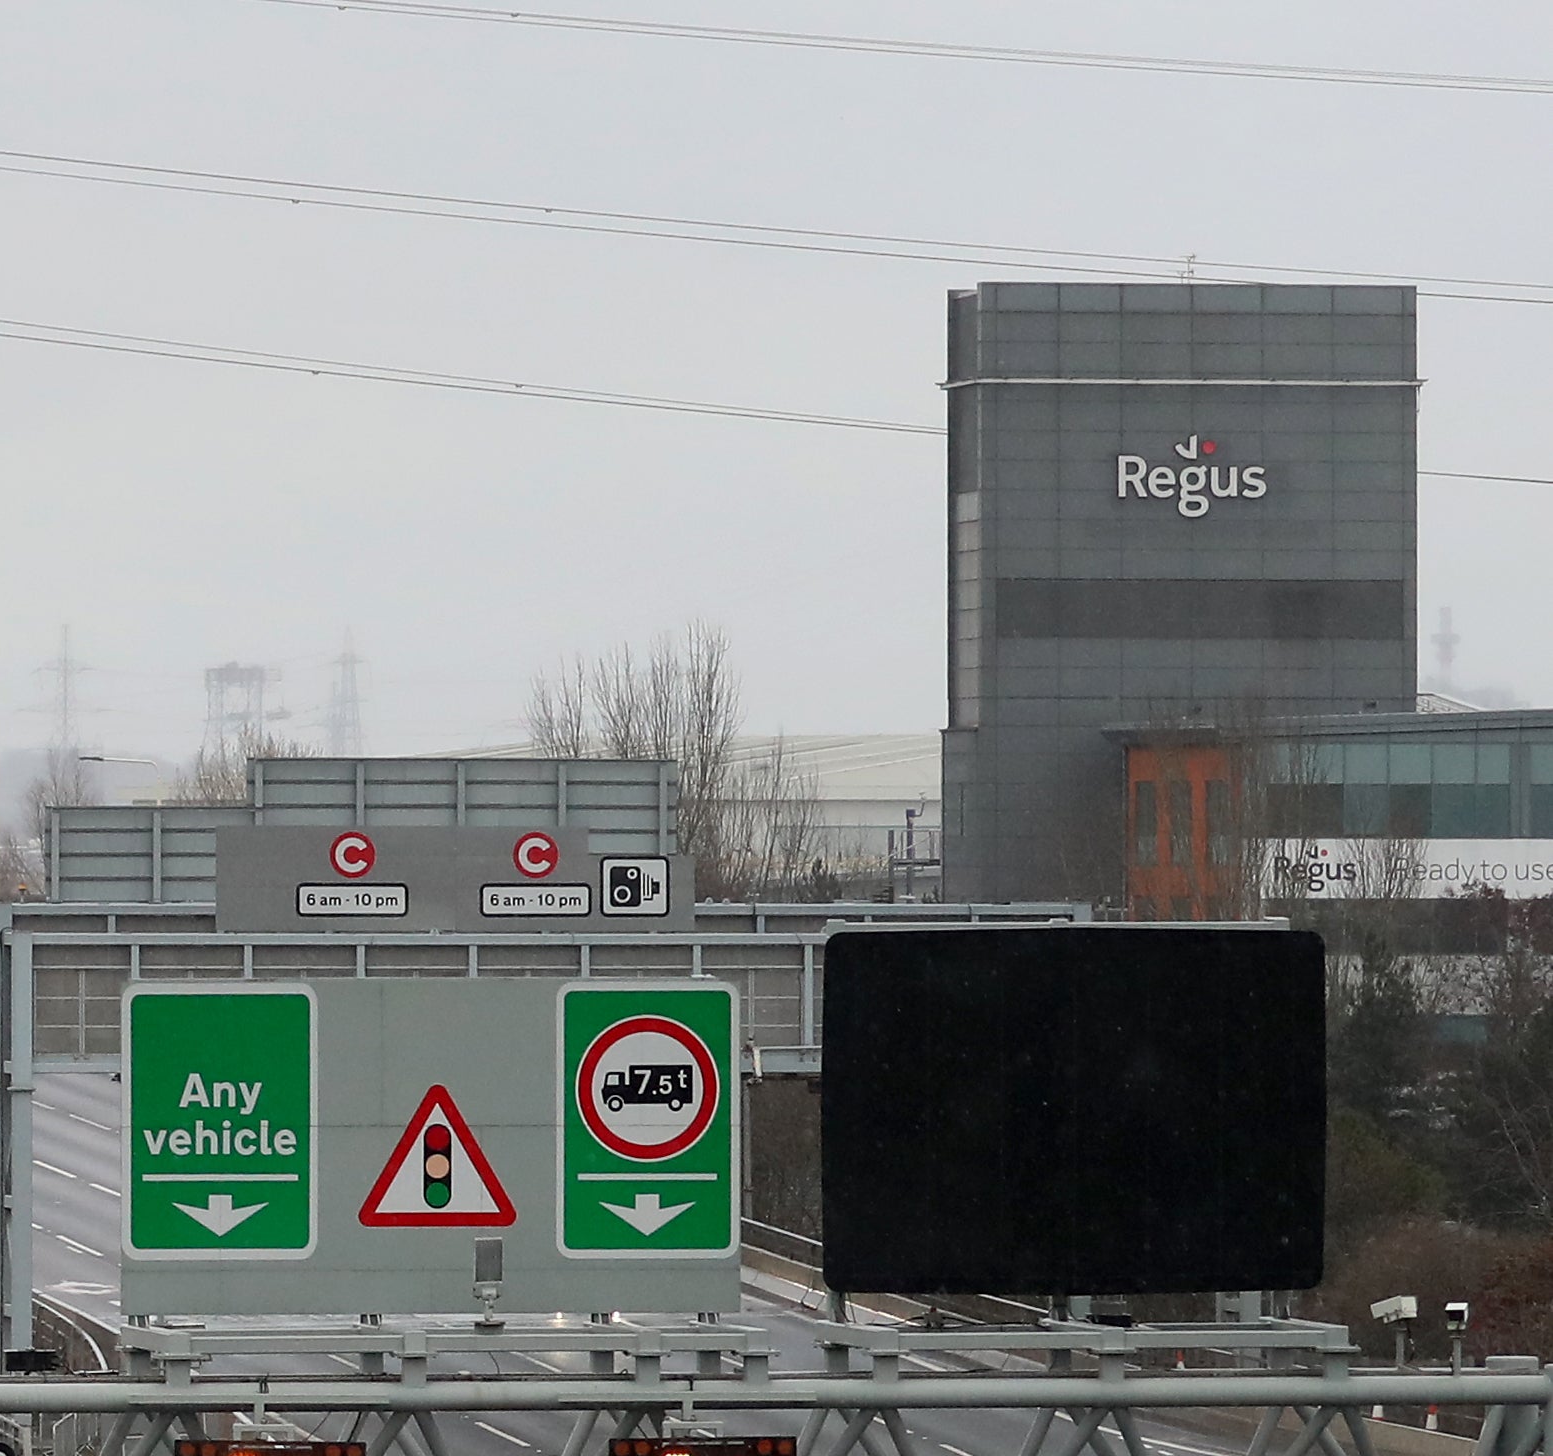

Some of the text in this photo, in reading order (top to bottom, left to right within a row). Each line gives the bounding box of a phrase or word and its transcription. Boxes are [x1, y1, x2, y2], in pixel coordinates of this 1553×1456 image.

[1118, 455, 1267, 517] Regus
[1274, 856, 1357, 892] Regus
[1481, 859, 1507, 881] to
[306, 892, 316, 906] 6
[320, 896, 342, 906] am
[354, 892, 371, 906] 10
[375, 896, 398, 908] pm
[489, 892, 499, 906] 6
[503, 896, 525, 906] am
[537, 892, 555, 906] 10
[559, 896, 581, 908] pm
[179, 1073, 262, 1115] Any
[143, 1120, 297, 1156] vehicle
